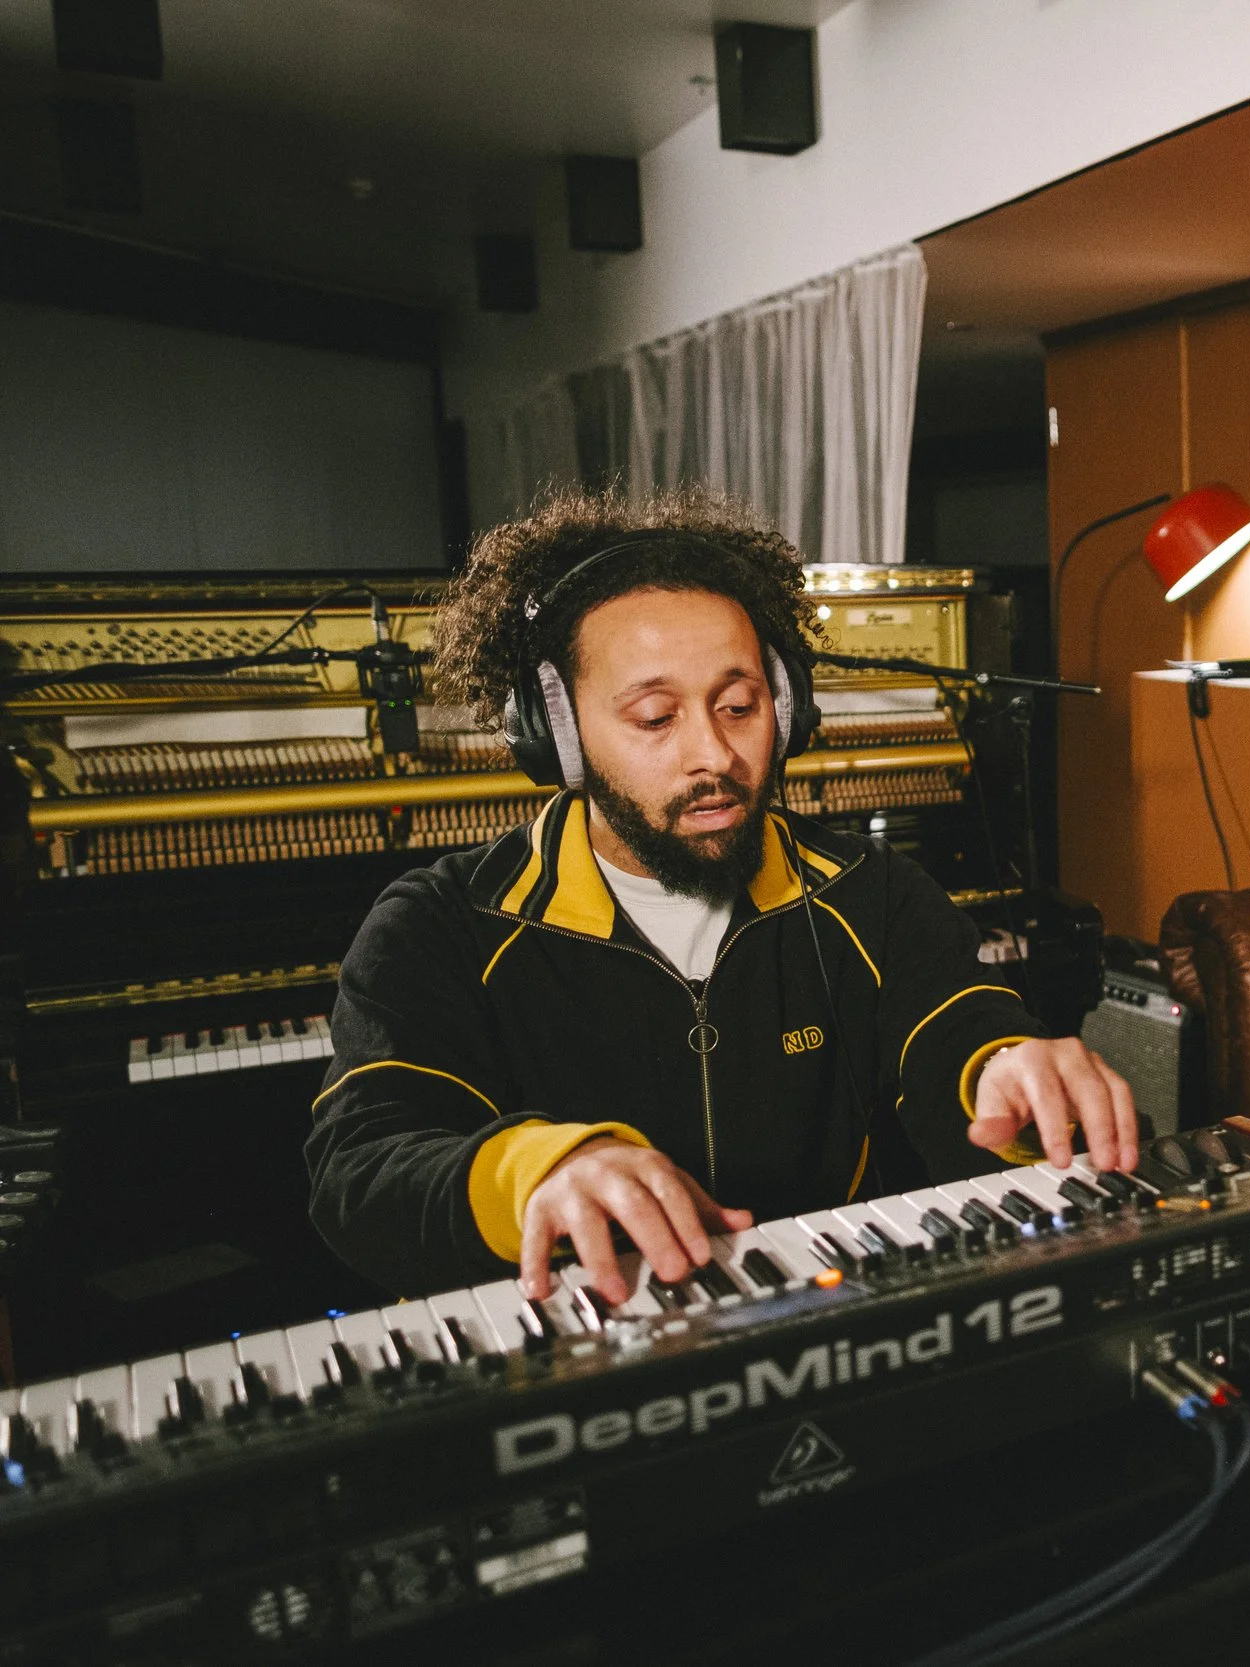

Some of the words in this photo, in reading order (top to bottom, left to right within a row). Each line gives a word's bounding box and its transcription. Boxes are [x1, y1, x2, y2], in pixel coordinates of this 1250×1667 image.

[782, 1026, 824, 1055] ND
[493, 1313, 953, 1476] DeepMind
[965, 1285, 1064, 1343] 12
